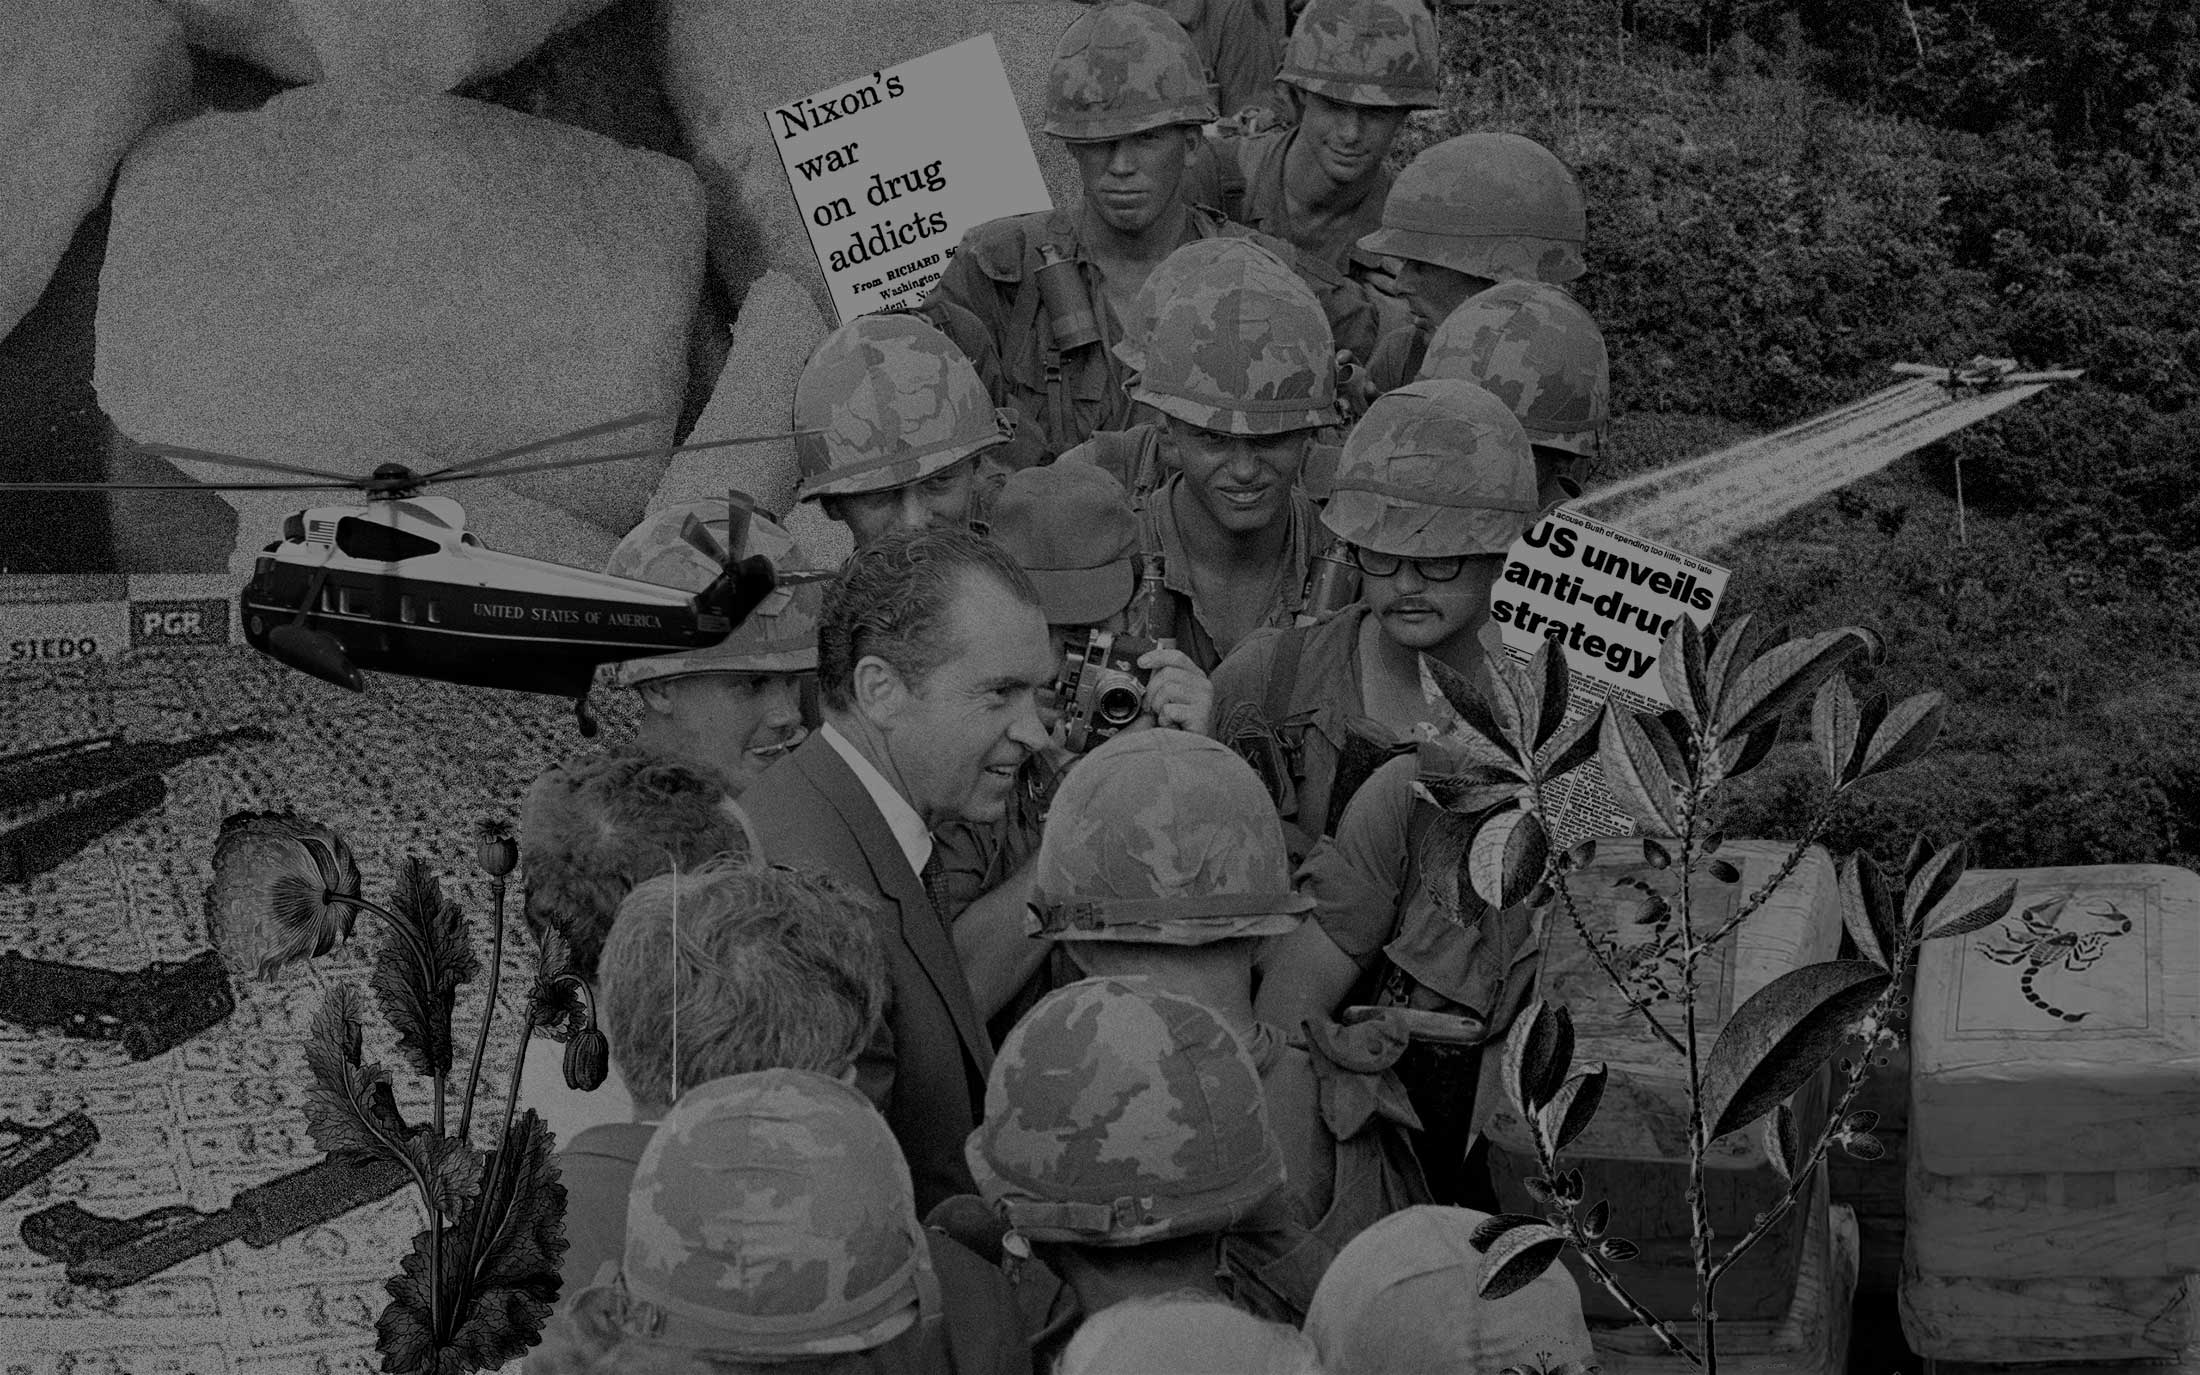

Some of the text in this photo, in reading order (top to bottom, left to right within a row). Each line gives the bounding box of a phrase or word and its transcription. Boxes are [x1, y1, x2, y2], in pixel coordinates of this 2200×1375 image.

[776, 72, 904, 139] Nixon's
[795, 142, 859, 181] war
[813, 160, 946, 226] on drug
[829, 211, 948, 272] addicts
[852, 278, 882, 294] From
[886, 254, 940, 281] RICHARD
[880, 272, 940, 300] Washington
[1556, 511, 1584, 527] accuse
[1584, 521, 1605, 535] Bush
[1614, 533, 1650, 553] spending
[1523, 521, 1714, 610] US unveils
[143, 611, 202, 637] PGR
[473, 603, 663, 629] UNITED STATES OF AMERICA
[1491, 599, 1656, 679] strategy
